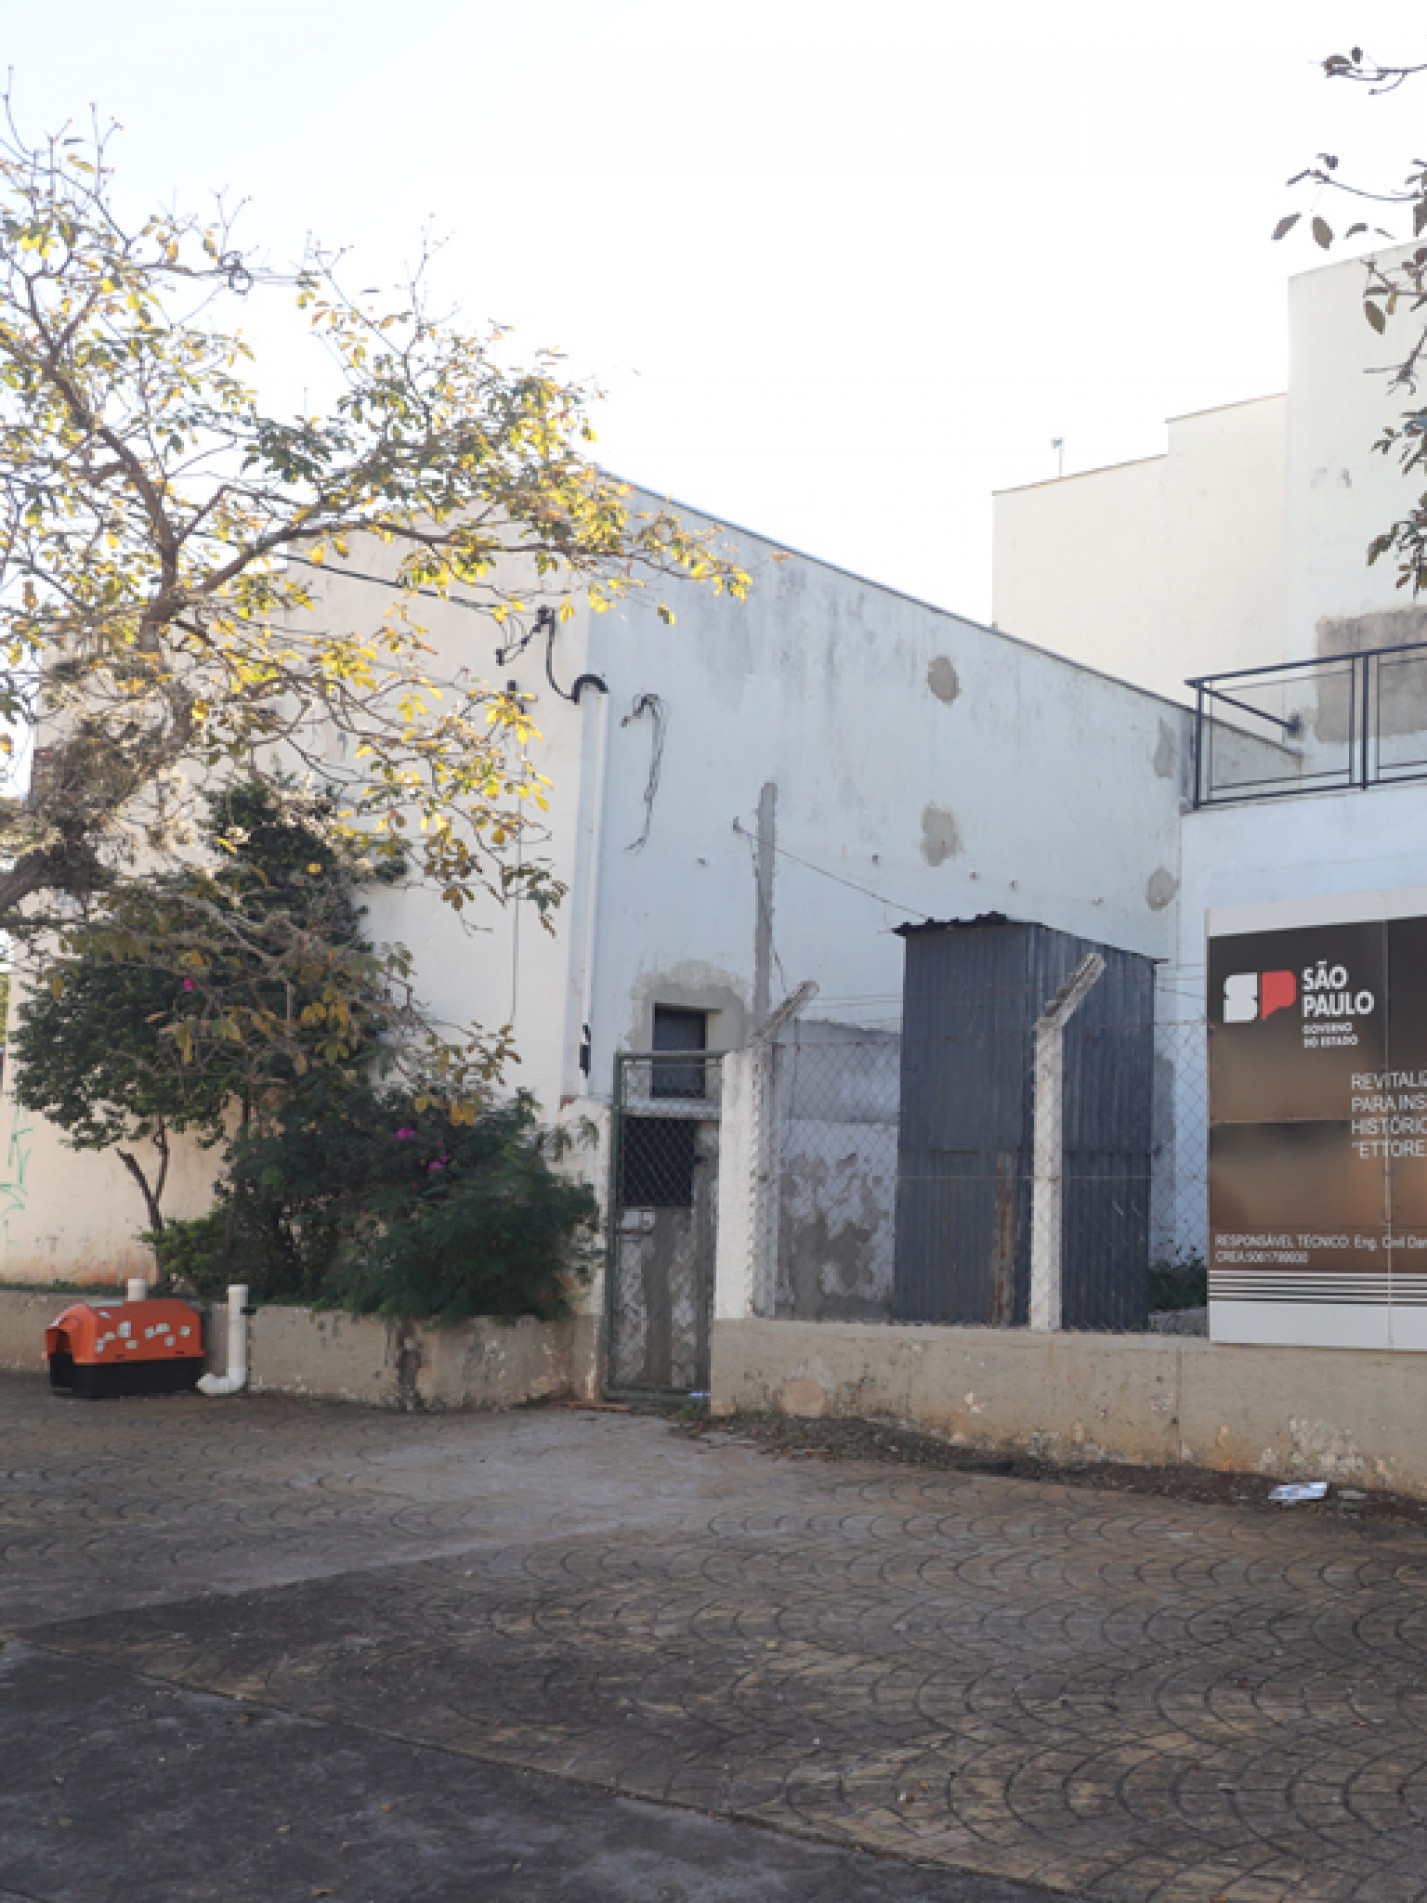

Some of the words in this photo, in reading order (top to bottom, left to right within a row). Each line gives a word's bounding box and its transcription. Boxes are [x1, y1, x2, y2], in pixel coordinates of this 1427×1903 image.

[1302, 959, 1349, 990] SÃO
[1302, 989, 1375, 1018] PAULO
[1302, 1022, 1353, 1034] GOVERNO
[1303, 1036, 1319, 1048] DO
[1320, 1033, 1359, 1046] ESTADO
[1351, 1095, 1396, 1113] PARA
[1214, 1231, 1295, 1248] RESPONSÁVEL
